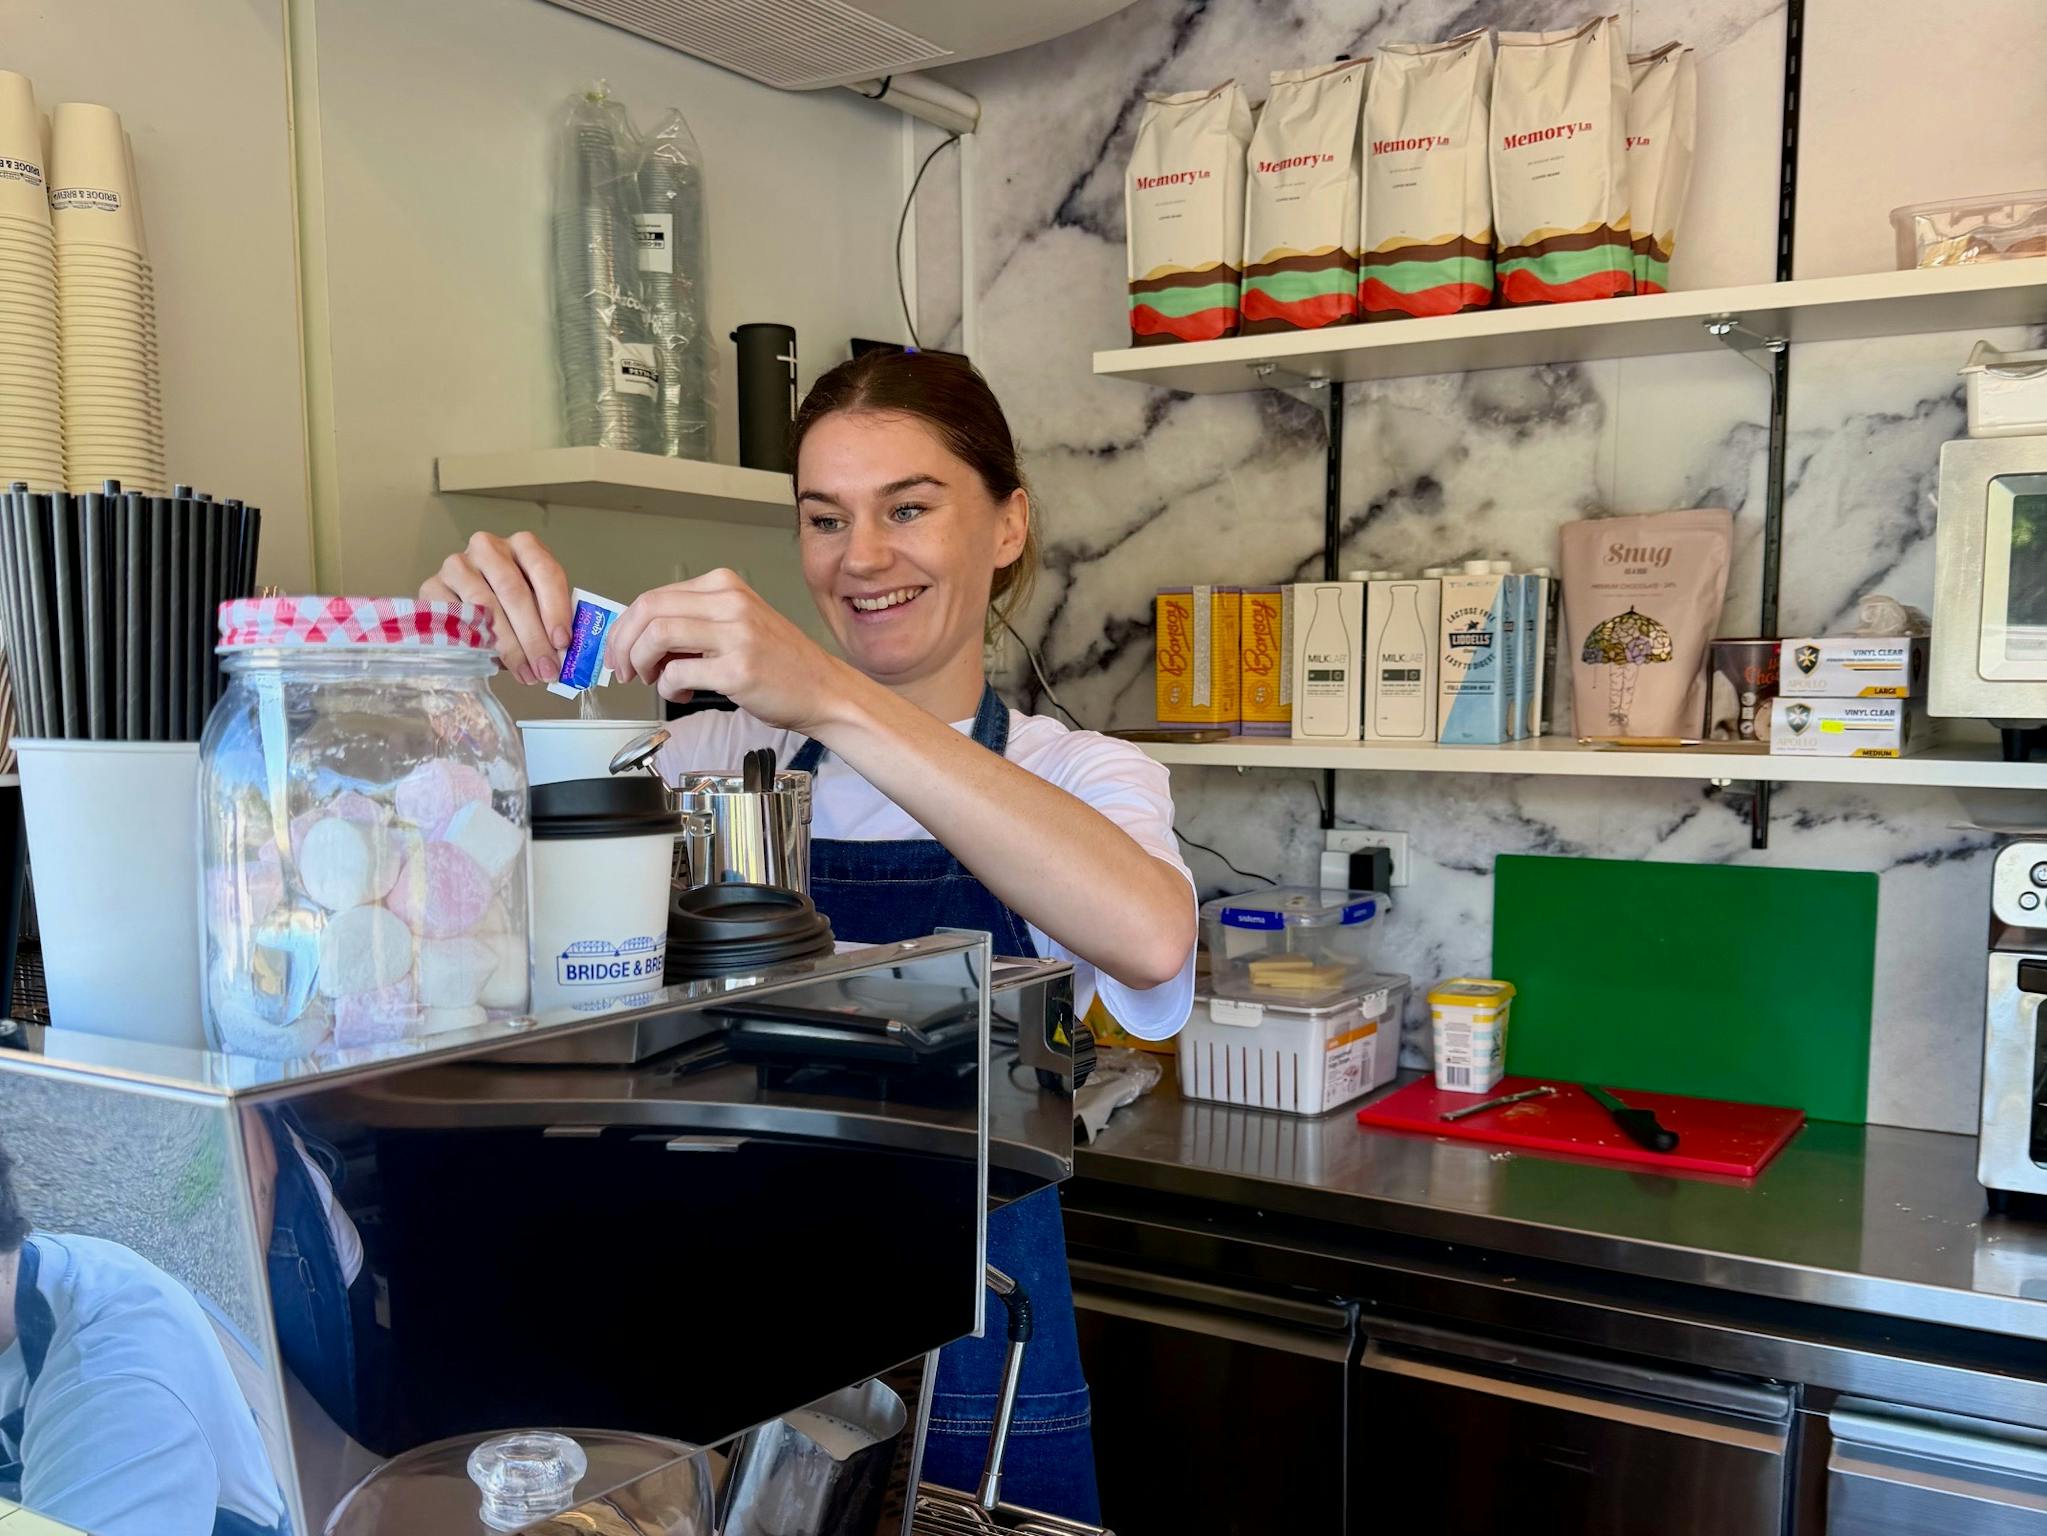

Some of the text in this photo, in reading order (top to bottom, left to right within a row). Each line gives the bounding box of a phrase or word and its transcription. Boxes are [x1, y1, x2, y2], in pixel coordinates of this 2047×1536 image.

[1504, 122, 1592, 150] Memory Ln
[1636, 136, 1650, 146] Ln
[1372, 136, 1450, 156] Memory Ln
[5, 160, 12, 169] &
[14, 161, 40, 176] BRIDGE
[1257, 154, 1334, 173] Memory Ln
[1136, 170, 1211, 191] Memory Ln
[79, 190, 85, 198] &
[86, 190, 118, 202] BRIDGE
[1603, 543, 1673, 568] Snug
[1159, 600, 1191, 677] Bonsoy
[1244, 600, 1278, 677] Bonsoy
[1853, 649, 1903, 657] VINYL CLEAR
[1787, 680, 1827, 688] APOLLO
[1845, 709, 1895, 717] VINYL CLEAR
[1777, 738, 1817, 746] APOLLO
[566, 955, 662, 981] BRIDGE & BRE
